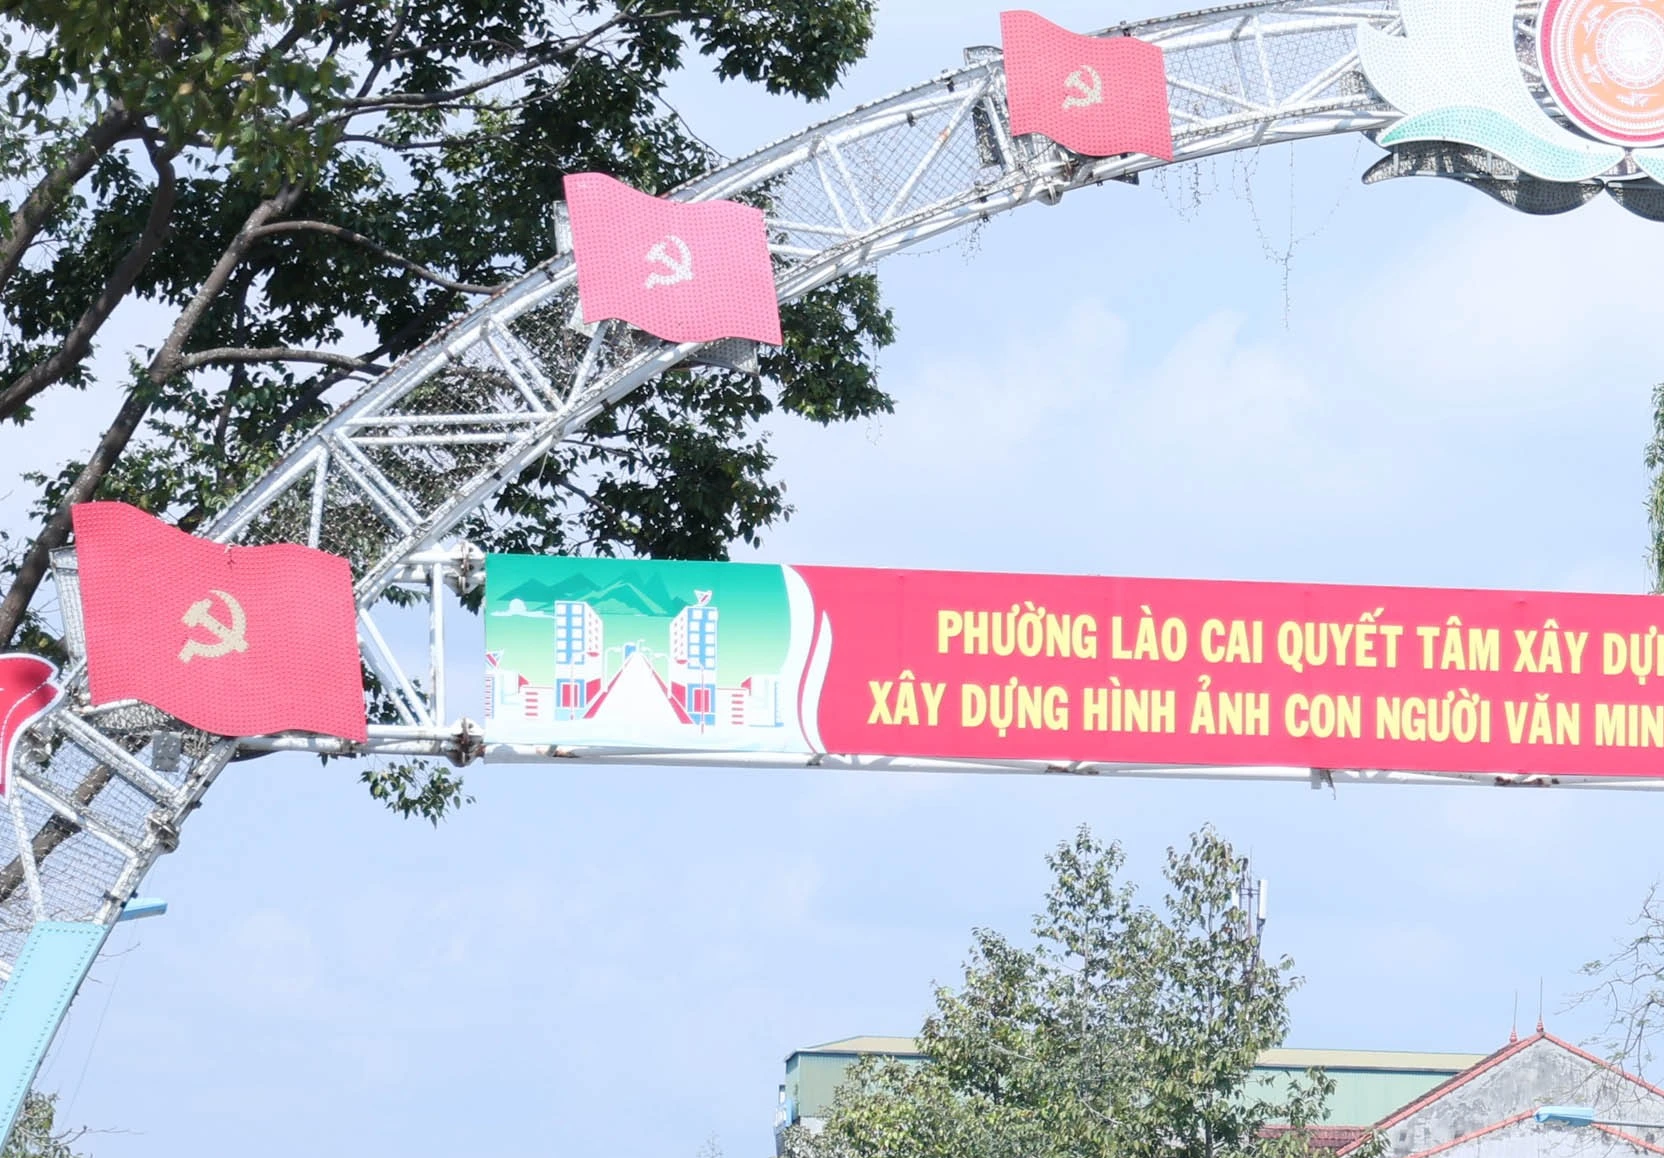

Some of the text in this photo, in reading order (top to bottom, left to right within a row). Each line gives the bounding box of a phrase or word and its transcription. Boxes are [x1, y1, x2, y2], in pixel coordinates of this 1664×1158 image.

[938, 601, 1096, 658] PHƯỜNG
[1112, 605, 1187, 661] LÀO
[1201, 619, 1262, 663] CAI
[1278, 608, 1403, 672] QUYẾT
[1417, 616, 1499, 671] TÂM
[1514, 619, 1588, 674] XÂY
[868, 670, 946, 726] XÂY
[962, 677, 1068, 737] DỰNG
[1084, 677, 1175, 733] HÌNH
[1190, 675, 1269, 735] ẢNH
[1285, 693, 1361, 738] CON
[1377, 688, 1490, 742] NGƯỜI
[1504, 693, 1580, 745] VĂN
